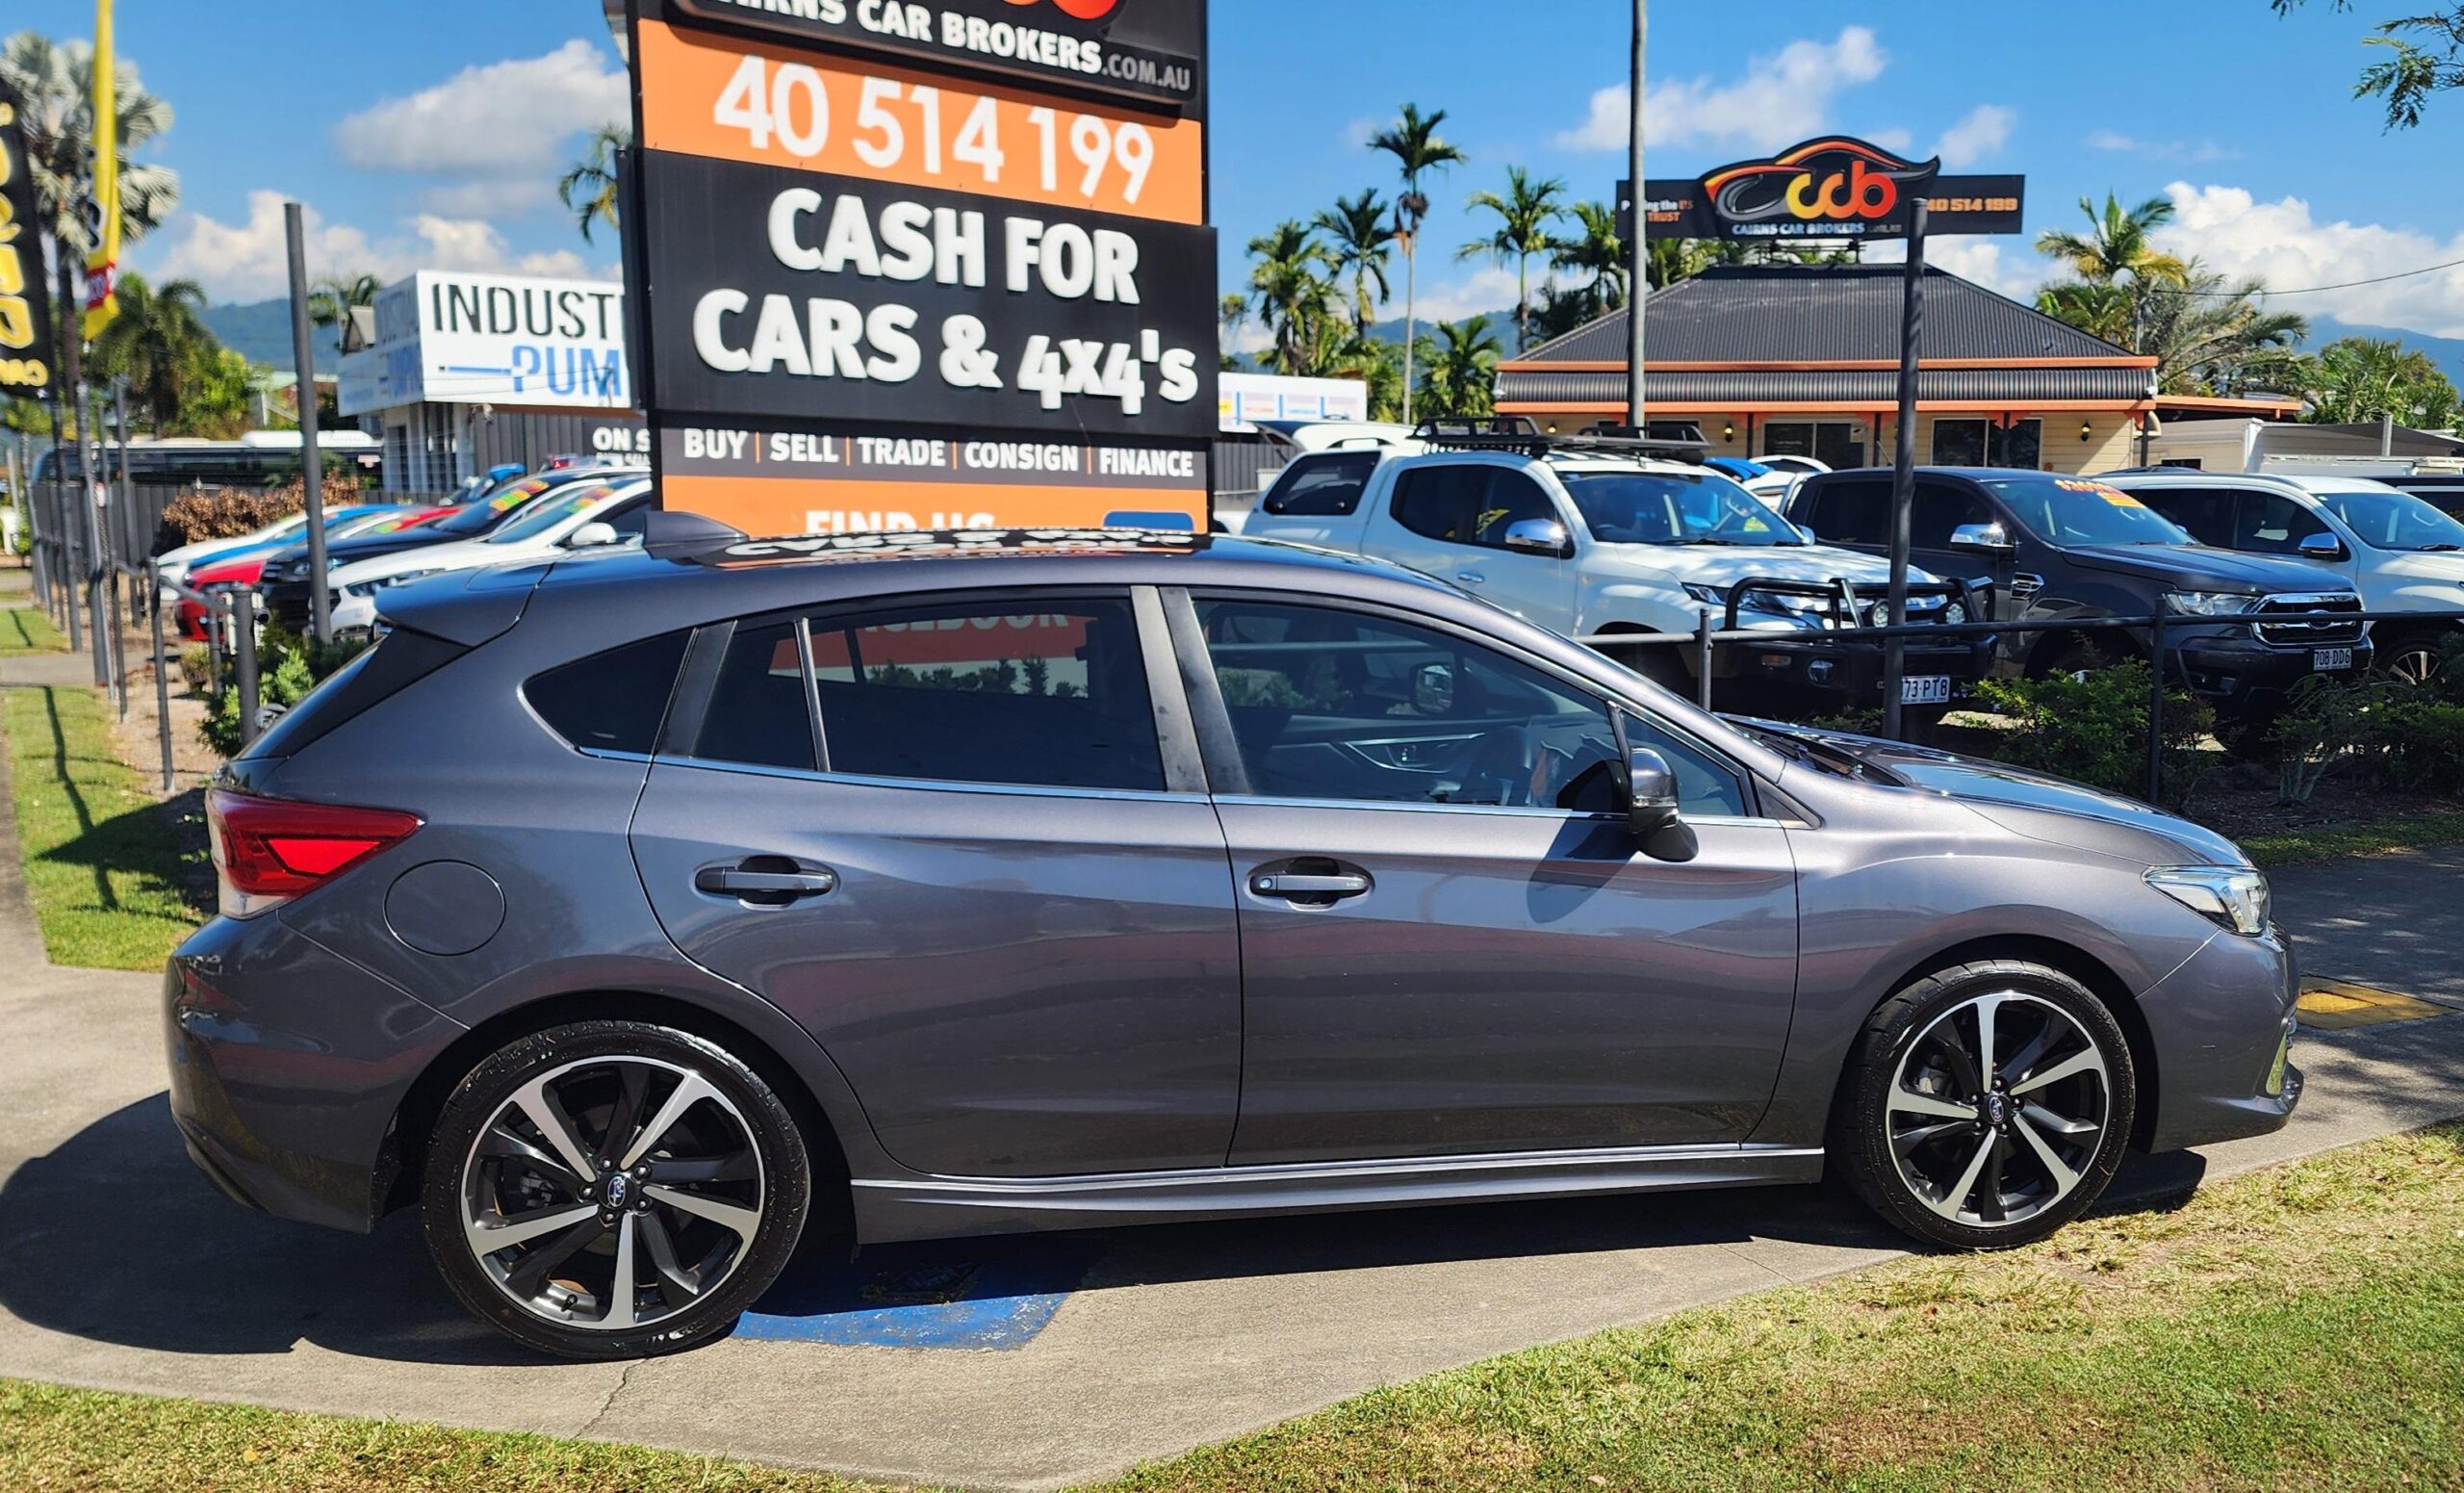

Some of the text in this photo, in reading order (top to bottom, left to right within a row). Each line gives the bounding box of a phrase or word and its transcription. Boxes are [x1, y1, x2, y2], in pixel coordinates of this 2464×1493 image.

[856, 0, 933, 42] CAR
[712, 55, 1154, 204] 40 514 199
[1732, 224, 1778, 235] CAIRNS
[1780, 223, 1805, 234] CAR
[1807, 223, 1864, 234] BROKERS
[1950, 198, 1983, 211] 514
[767, 188, 1141, 304] CASH FOR
[432, 283, 624, 339] INDUST
[693, 289, 921, 382] CARS
[939, 315, 1004, 389] &
[511, 345, 623, 397] PUM
[592, 426, 631, 450] ON
[683, 428, 749, 460] BUY
[770, 432, 838, 464] SELL
[857, 436, 945, 468] TRADE
[964, 441, 1078, 472] CONSIGN
[1099, 448, 1194, 478] FINANCE
